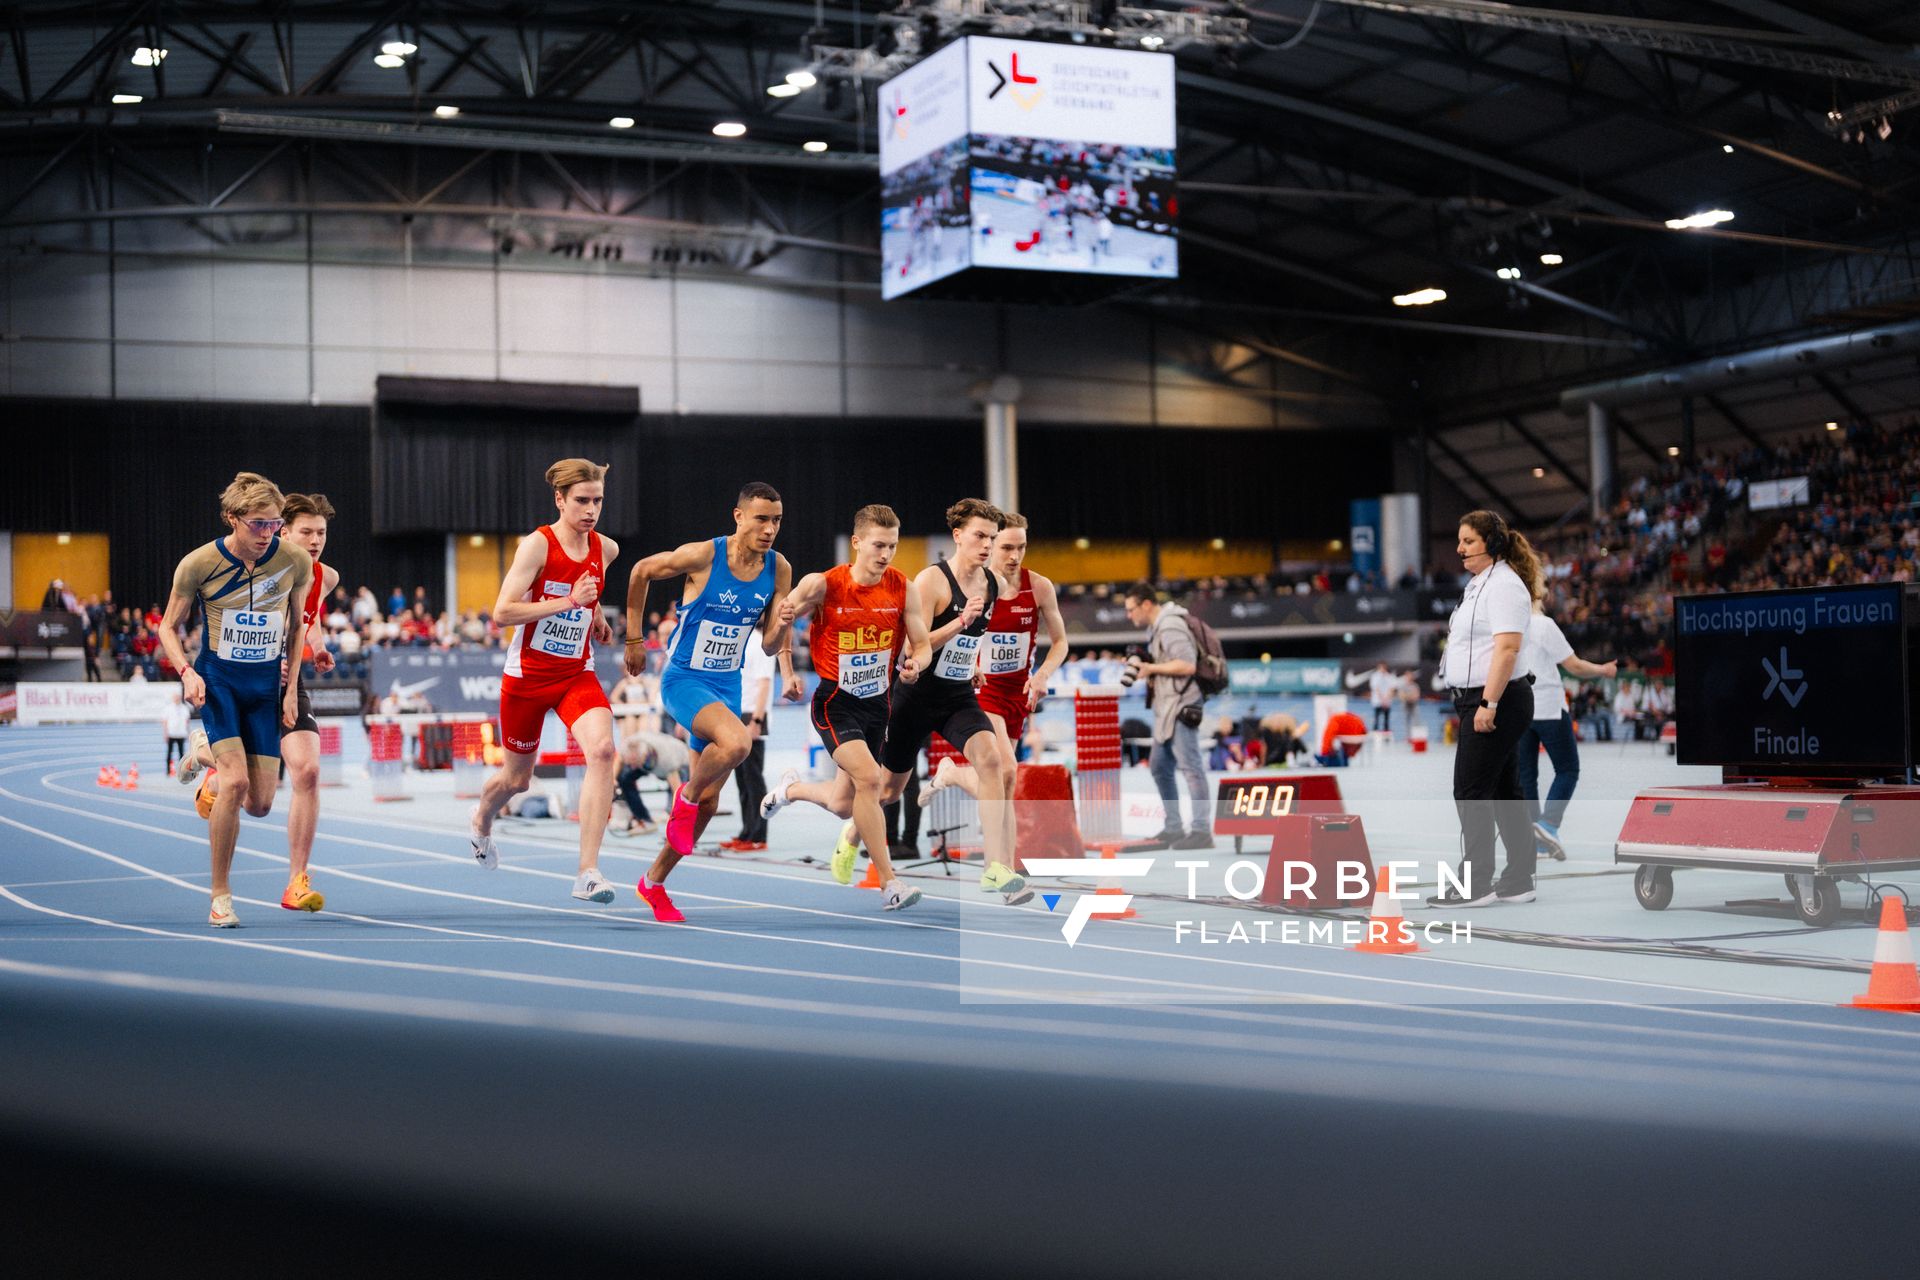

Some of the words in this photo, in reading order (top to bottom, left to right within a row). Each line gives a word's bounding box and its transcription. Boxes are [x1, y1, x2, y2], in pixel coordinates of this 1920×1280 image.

[235, 613, 267, 626] GLS
[555, 610, 582, 622] GLS
[1683, 603, 1806, 637] Hochsprung
[1814, 597, 1893, 624] Frauen
[224, 627, 277, 645] M.TORTELL
[543, 621, 584, 641] ZAHLTEN
[712, 626, 740, 638] GLS
[957, 637, 978, 649] GLS
[992, 634, 1017, 645] GLS
[703, 640, 738, 656] ZITTEL
[991, 647, 1020, 661] LÖBE
[851, 654, 878, 667] GLS
[842, 664, 886, 685] A.BEIMLER
[25, 688, 61, 706] Black
[1754, 727, 1820, 754] Finale
[1233, 785, 1294, 817] 1:00
